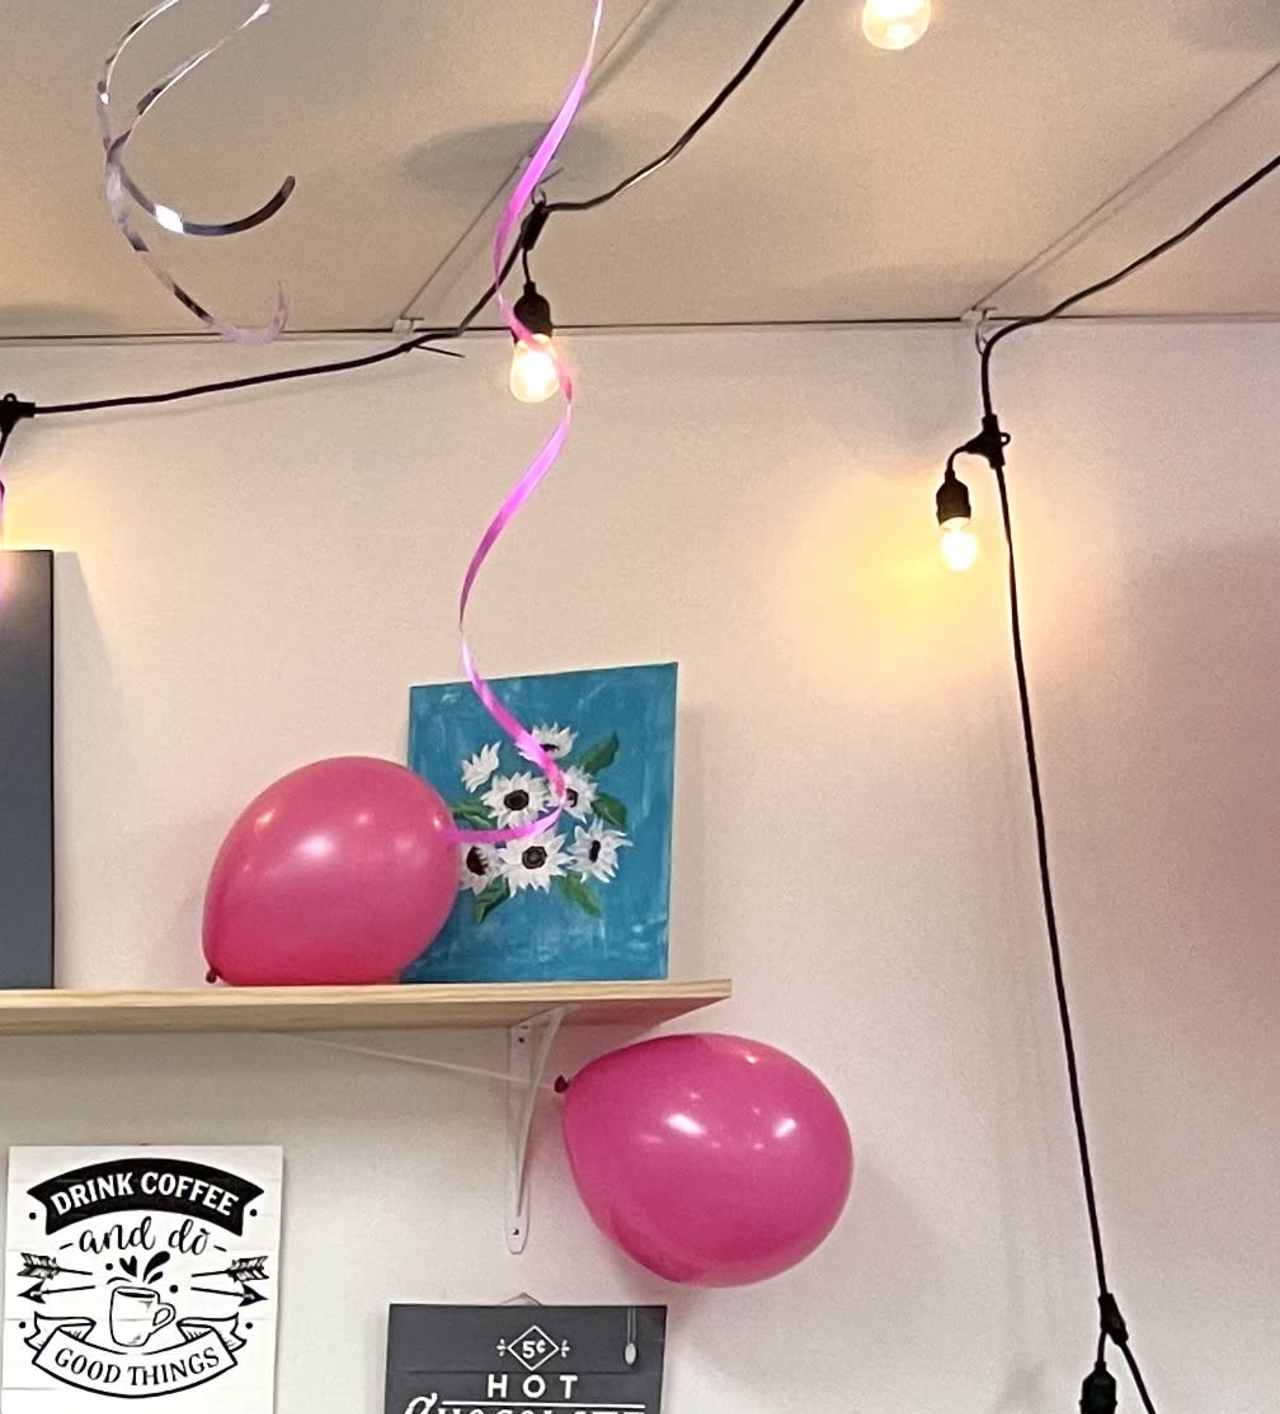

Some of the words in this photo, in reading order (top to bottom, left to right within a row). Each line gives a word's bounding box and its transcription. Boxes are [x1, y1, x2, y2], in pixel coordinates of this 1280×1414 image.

[50, 1171, 134, 1216] DRINK
[139, 1171, 240, 1217] COFFEE
[78, 1215, 157, 1255] and
[167, 1217, 211, 1256] do
[54, 1347, 122, 1384] GOOD
[127, 1346, 220, 1386] THINGS
[487, 1374, 579, 1399] HOT
